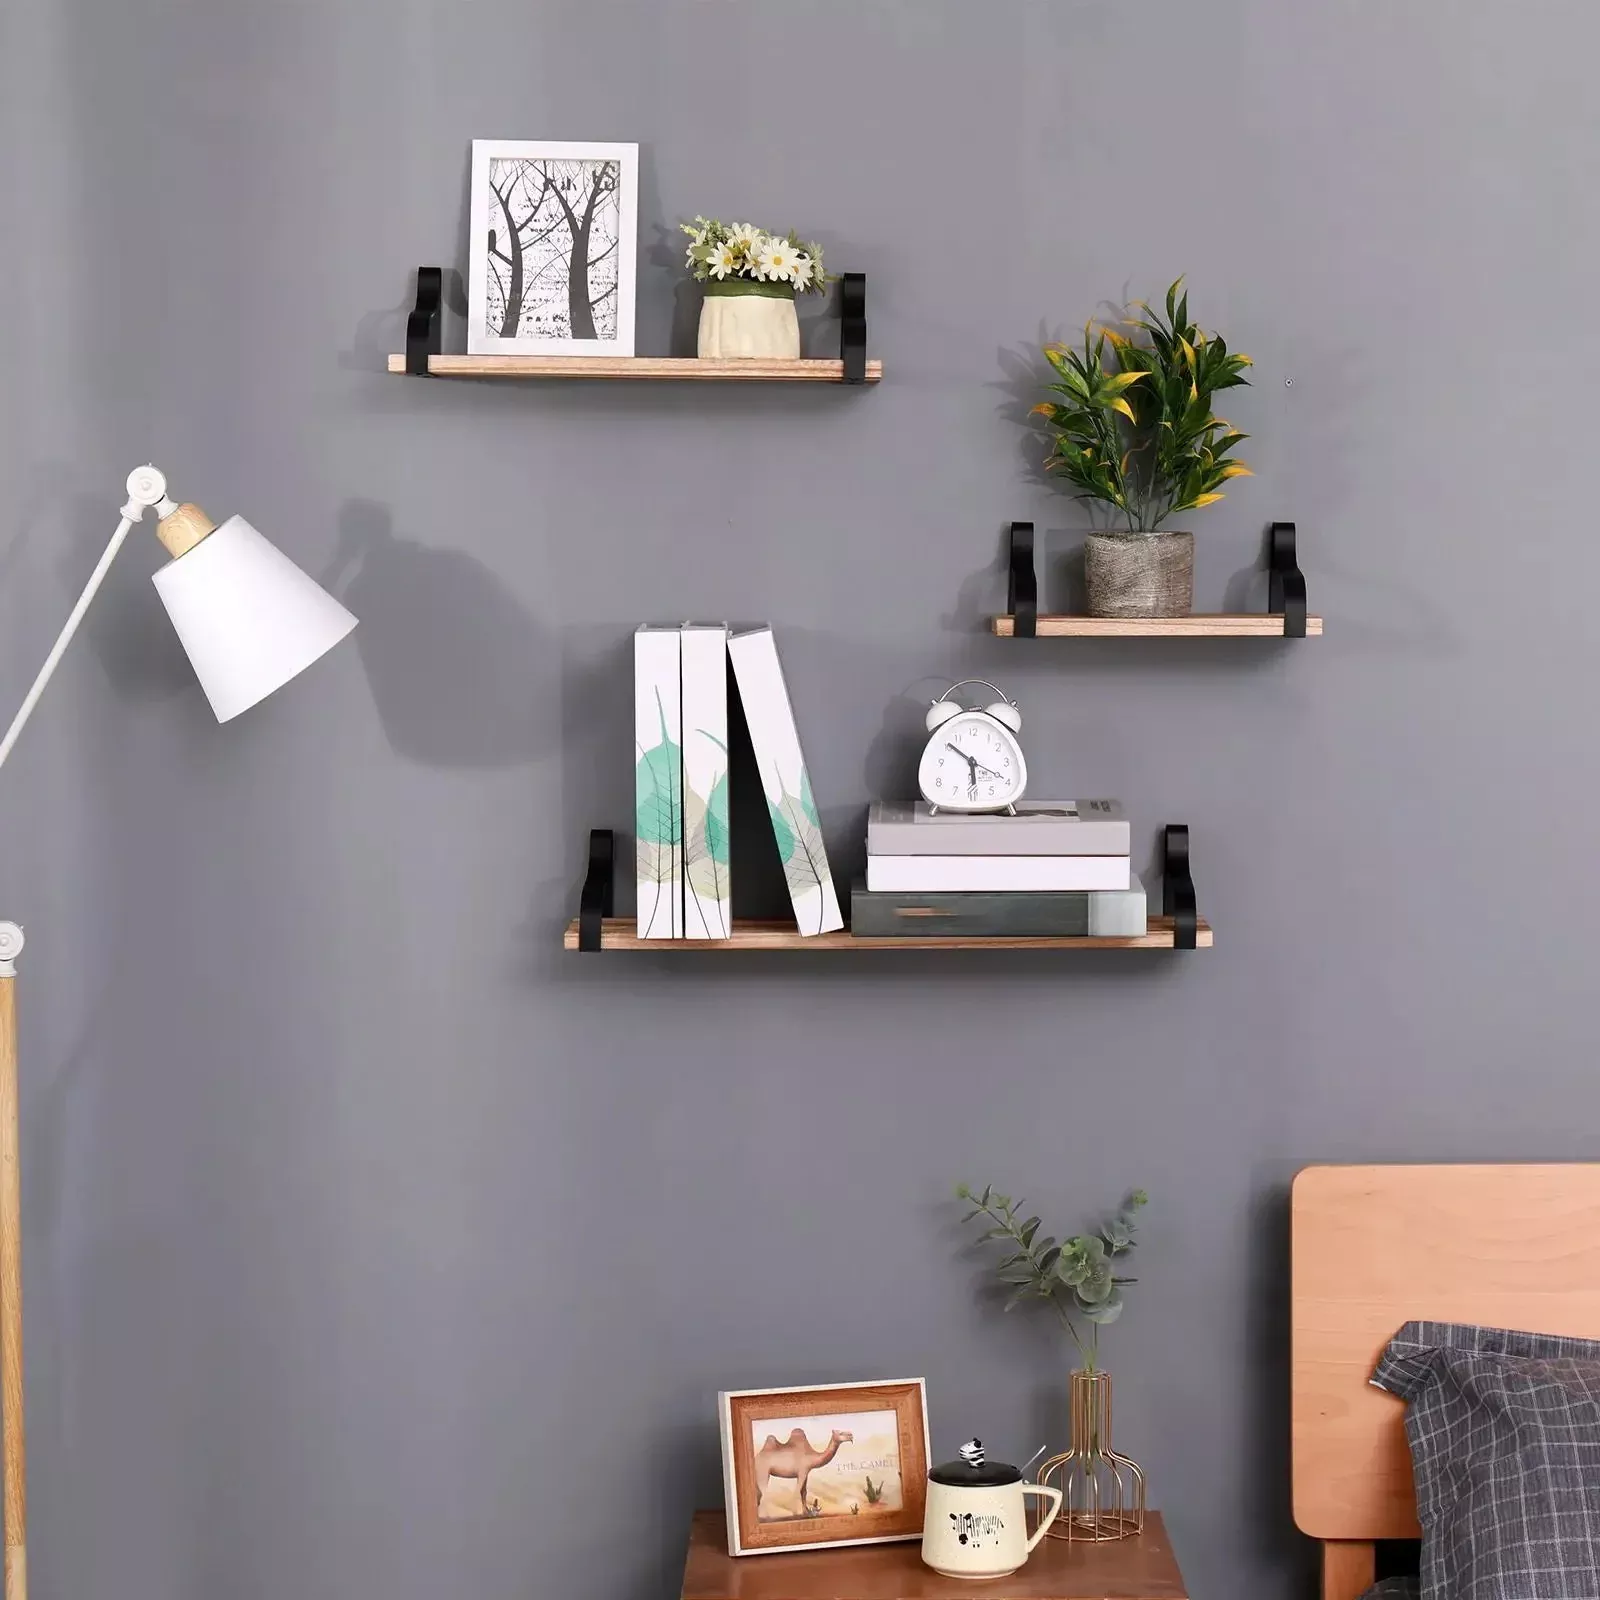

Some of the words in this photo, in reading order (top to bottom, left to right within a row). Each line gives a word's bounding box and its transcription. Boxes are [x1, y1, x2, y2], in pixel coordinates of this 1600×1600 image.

[969, 728, 978, 736] 12
[995, 743, 1001, 752] 2
[938, 758, 944, 767] 9
[1004, 758, 1010, 767] 3
[936, 778, 942, 787] 8
[1004, 778, 1010, 786] 4
[952, 786, 959, 795] 7
[988, 786, 994, 795] 5
[836, 1462, 857, 1473] THE
[860, 1459, 896, 1469] CAMEL
